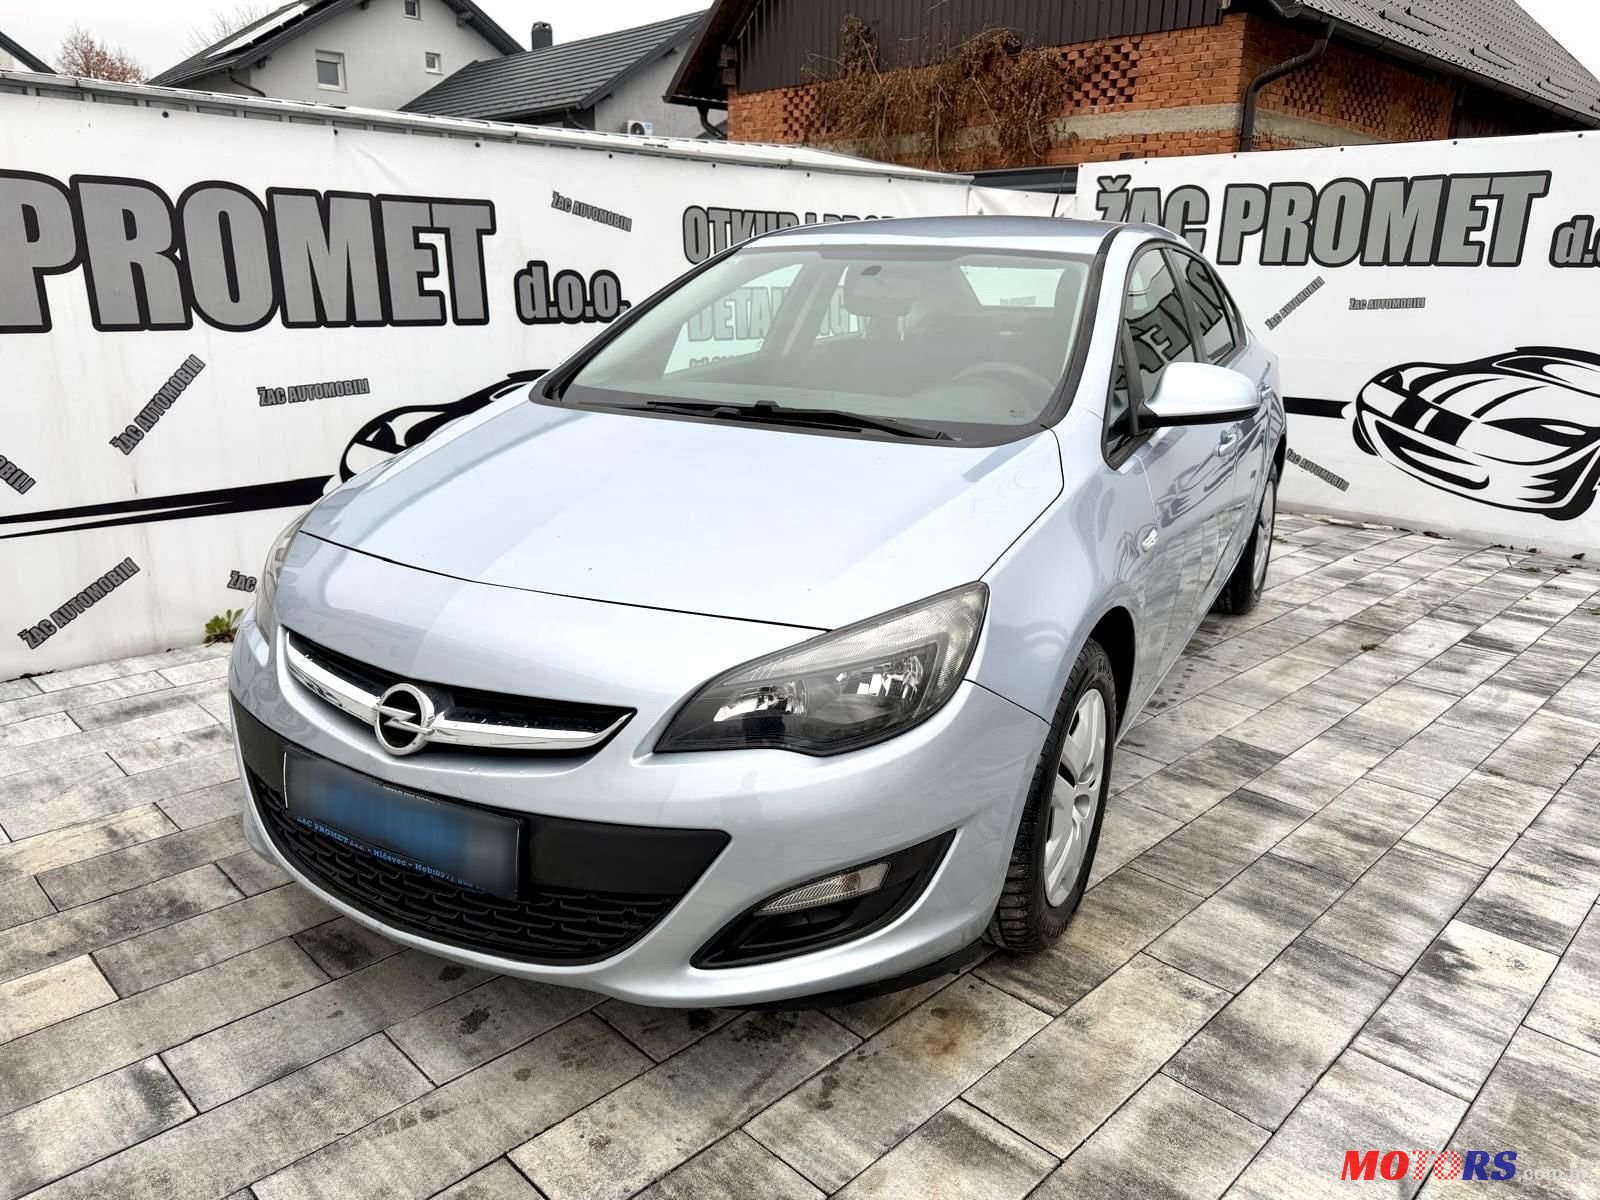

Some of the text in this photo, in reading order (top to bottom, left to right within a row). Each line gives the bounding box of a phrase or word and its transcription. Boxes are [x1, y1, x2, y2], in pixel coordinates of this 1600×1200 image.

[0, 169, 631, 332] PROMET d.o.o.
[572, 200, 632, 232] AUTOMOBILI
[683, 205, 800, 265] OTK
[1216, 170, 1552, 268] PROMET
[1549, 214, 1600, 268] d.
[1367, 297, 1426, 310] AUTOMOBILI
[109, 353, 206, 456] ŽAC AUTOMOBILI
[256, 378, 370, 407] ŽAC AUTOMOBILI
[17, 556, 141, 650] ŽAC AUTOMOBILI
